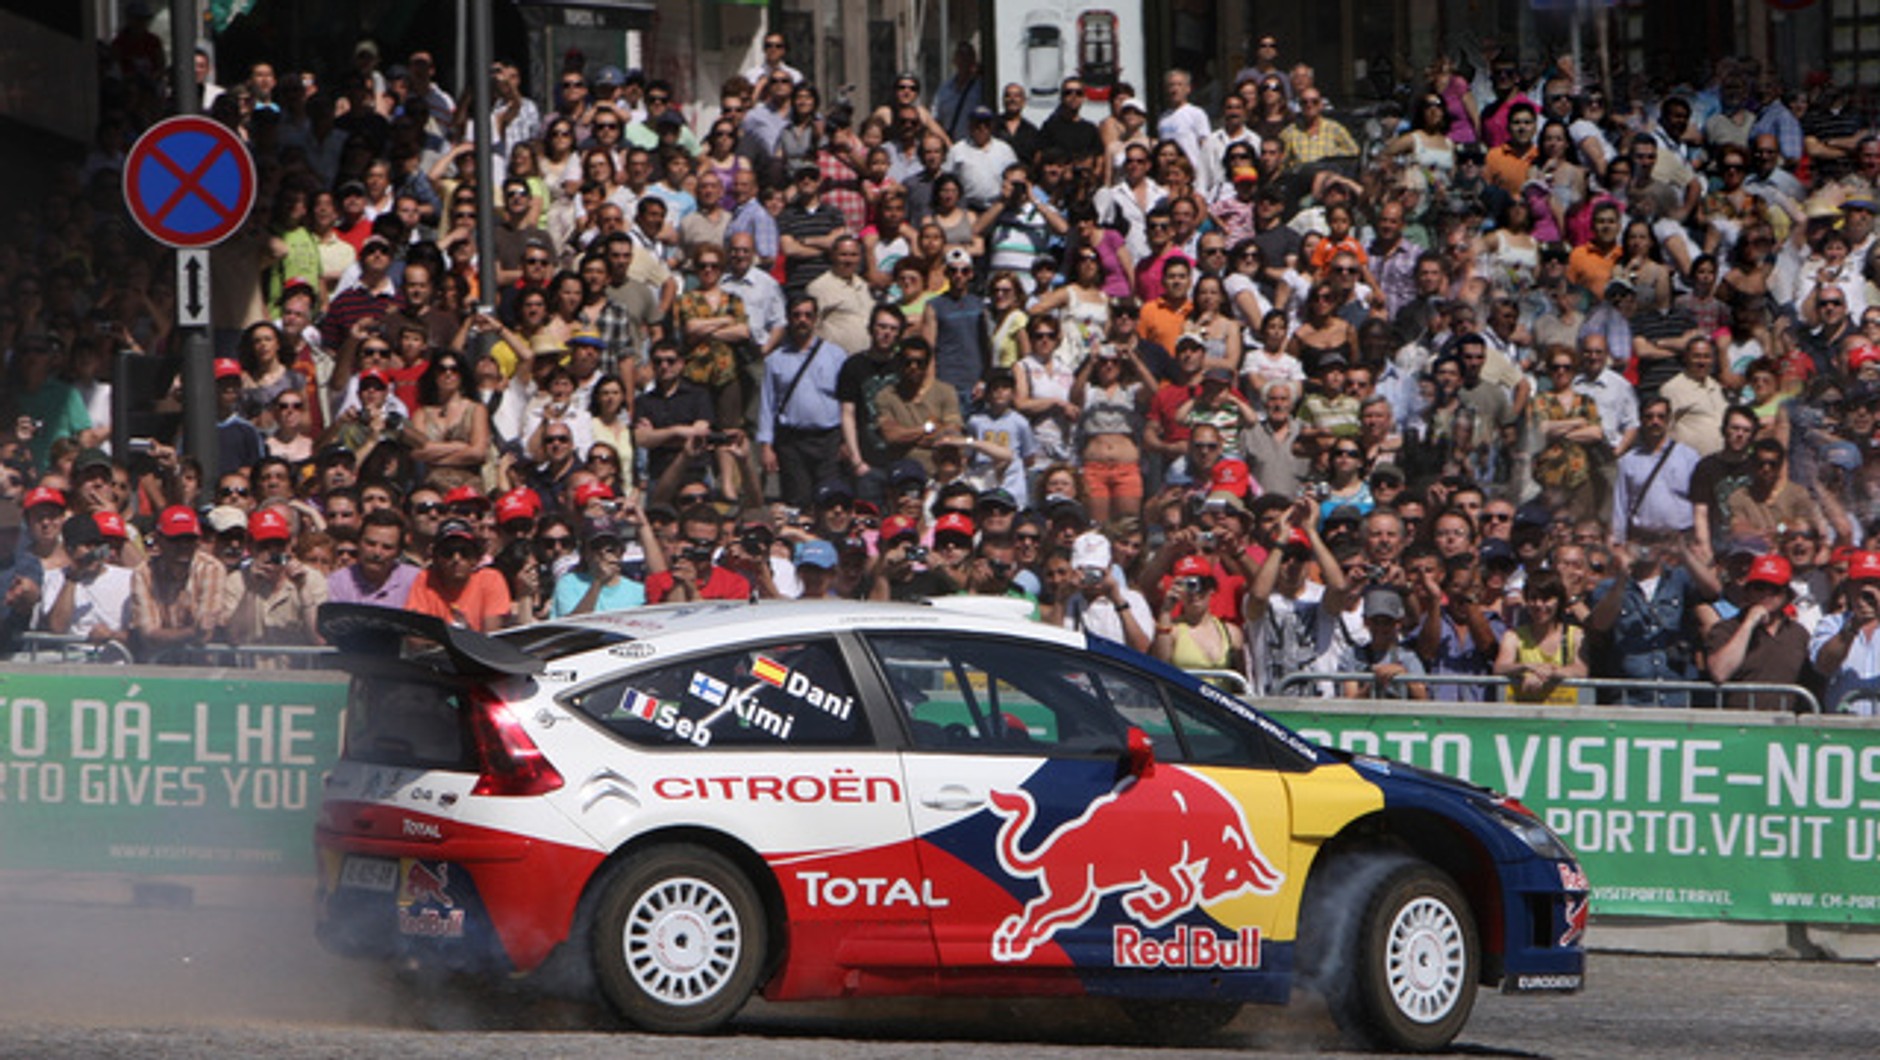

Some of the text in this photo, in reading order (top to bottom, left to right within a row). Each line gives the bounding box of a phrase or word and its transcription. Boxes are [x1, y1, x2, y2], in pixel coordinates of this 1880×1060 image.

[725, 687, 795, 741] Kimi
[786, 672, 854, 722] Dani
[0, 683, 315, 764] O DÁ-LHE
[656, 707, 712, 748] Seb
[0, 761, 308, 810] TO GIVES YOU
[1846, 818, 1880, 861] U
[797, 871, 949, 907] TOTAL
